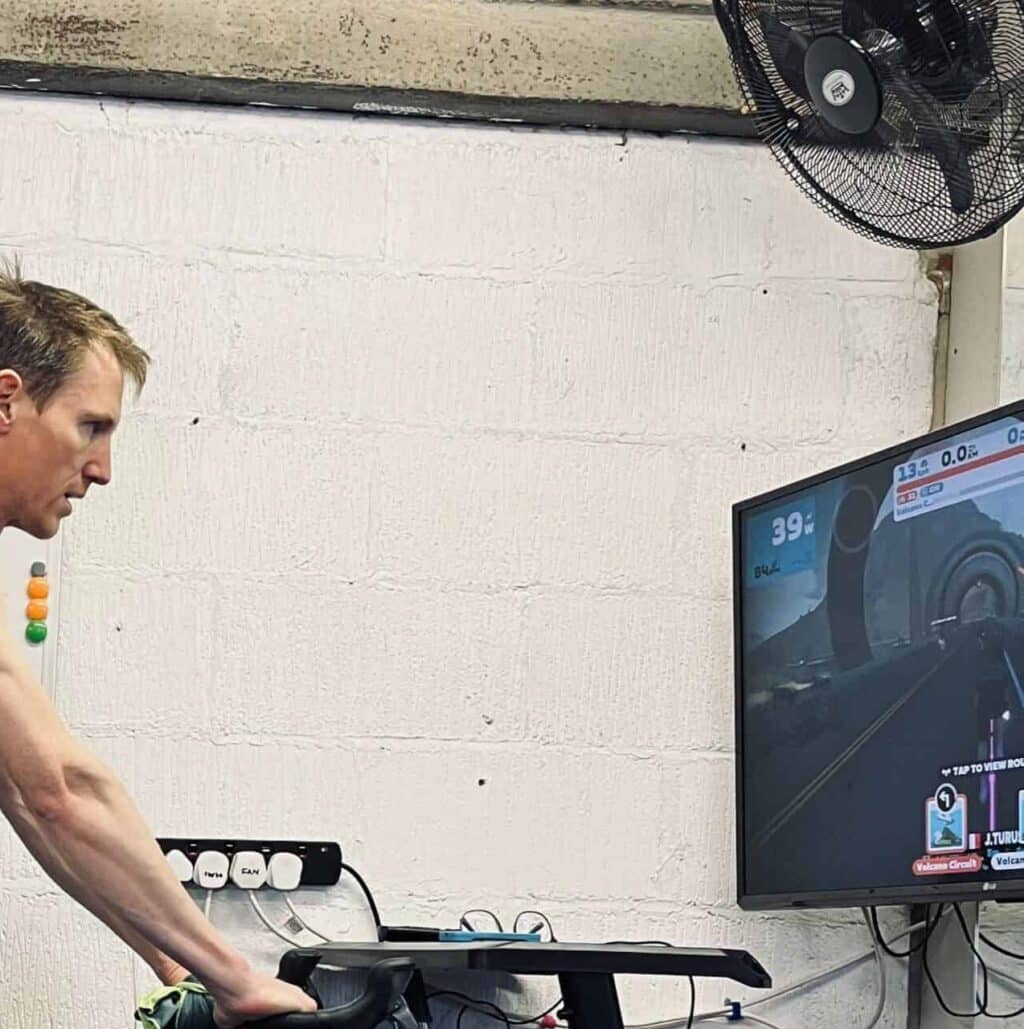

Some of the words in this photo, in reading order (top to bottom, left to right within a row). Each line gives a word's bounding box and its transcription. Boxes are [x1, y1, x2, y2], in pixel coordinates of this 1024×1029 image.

[772, 511, 803, 546] 39
[953, 766, 970, 776] TAP
[971, 763, 983, 774] TO
[984, 760, 1007, 772] VIEW
[984, 830, 1019, 846] J.TURU
